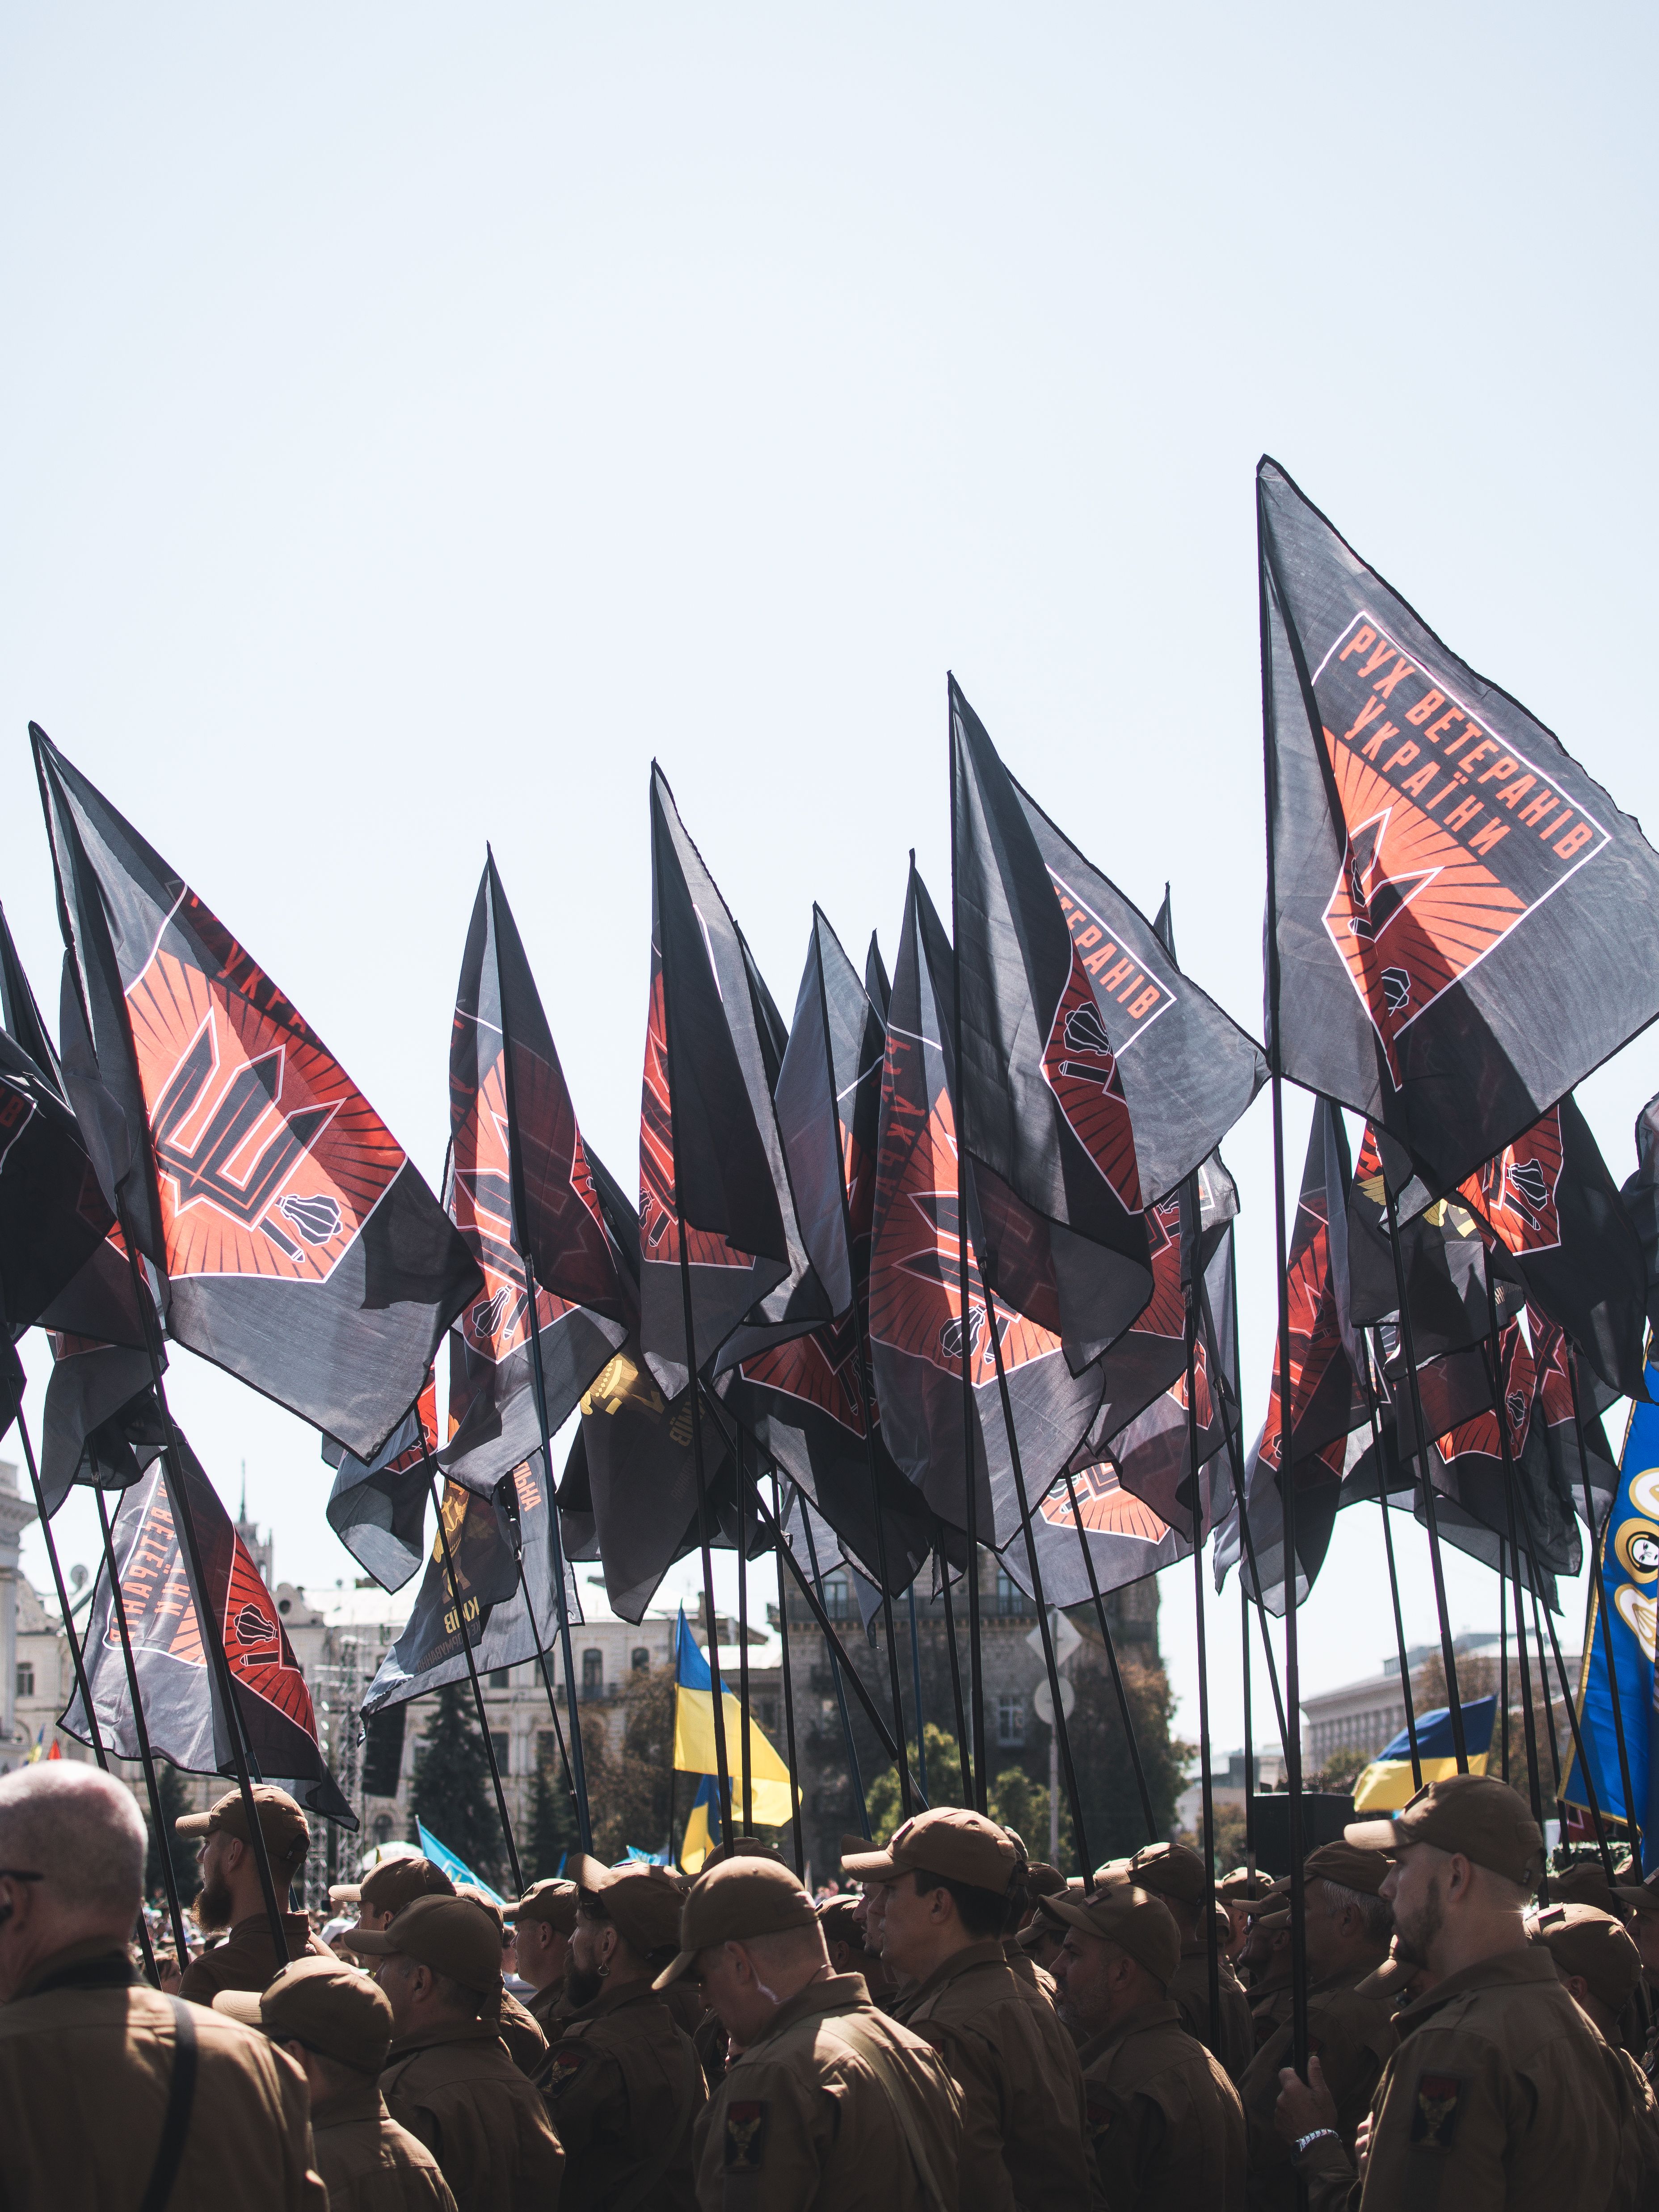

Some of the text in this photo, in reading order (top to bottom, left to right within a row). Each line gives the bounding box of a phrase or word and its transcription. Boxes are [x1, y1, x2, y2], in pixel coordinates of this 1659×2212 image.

[1339, 625, 1593, 860] РУХ ВЕТЕРАНІВ
[1344, 695, 1512, 856] УКРАЇНИ
